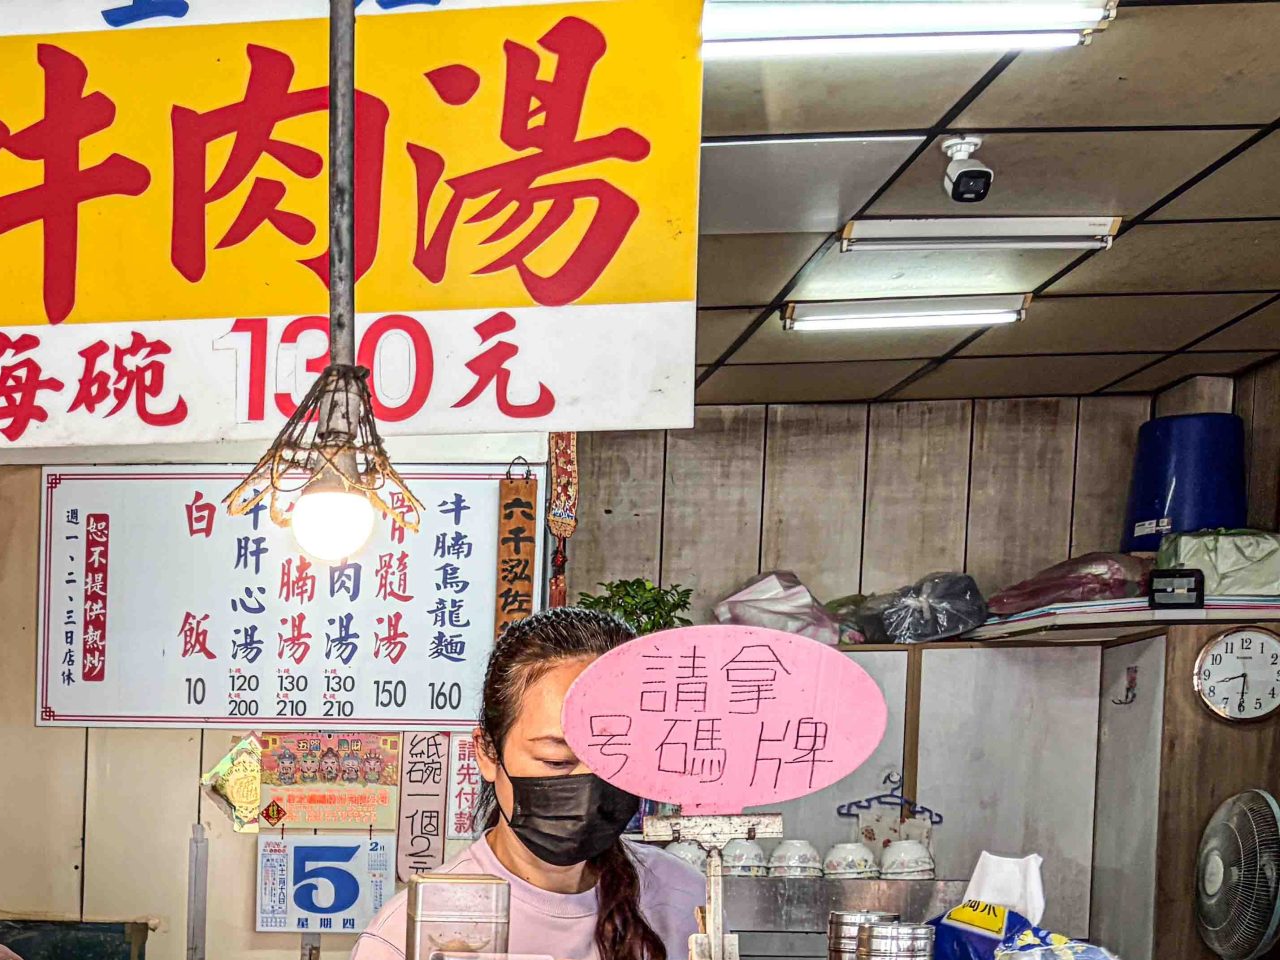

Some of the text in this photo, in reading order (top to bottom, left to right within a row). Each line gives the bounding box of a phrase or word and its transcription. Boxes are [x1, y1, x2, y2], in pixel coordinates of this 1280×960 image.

[230, 314, 434, 423] 130
[452, 312, 555, 419] 元
[277, 501, 316, 665] 腩湯
[83, 516, 108, 677] 恕不提供熱炒
[325, 558, 363, 665] 肉湯
[1225, 642, 1234, 654] 11
[1241, 638, 1252, 650] 12
[1211, 654, 1222, 665] 10
[1271, 653, 1279, 665] 2
[229, 675, 260, 692] 120
[277, 675, 309, 692] 130
[639, 645, 791, 714] 請拿
[1203, 669, 1211, 681] 9
[185, 677, 206, 705] 10
[324, 675, 356, 693] 130
[1208, 686, 1216, 698] 8
[373, 680, 407, 708] 150
[428, 682, 462, 710] 160
[1269, 687, 1276, 699] 4
[228, 699, 259, 717] 200
[276, 700, 307, 717] 210
[323, 700, 354, 717] 210
[1254, 698, 1262, 710] 5
[587, 714, 834, 789] 号碼牌
[454, 739, 479, 834] 請先付款
[293, 844, 361, 914] 5
[296, 917, 355, 929] 星期四
